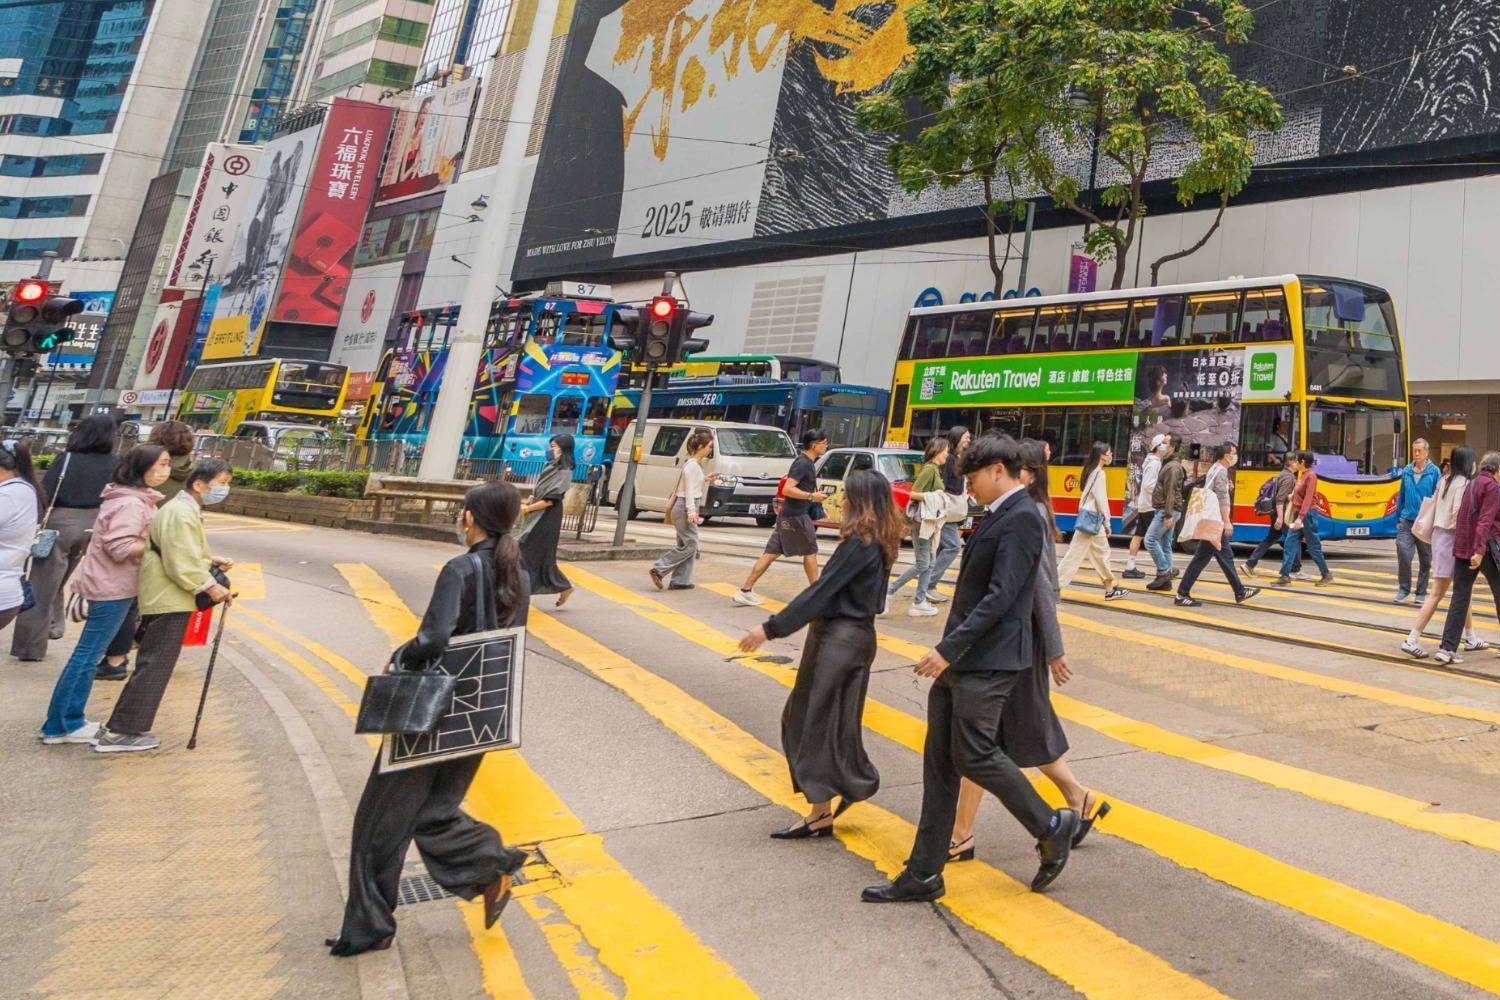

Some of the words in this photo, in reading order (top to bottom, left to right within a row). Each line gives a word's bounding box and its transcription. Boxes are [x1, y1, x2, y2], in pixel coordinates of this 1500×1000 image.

[328, 126, 363, 200] 六福珠寶
[641, 200, 694, 239] 2025
[699, 200, 751, 230] 敬请期待
[527, 247, 542, 257] MADE
[542, 245, 556, 255] WITH
[556, 243, 571, 254] LOVE
[571, 240, 582, 251] FOR
[582, 238, 594, 249] ZHU
[577, 284, 596, 295] 87
[544, 302, 557, 310] 87
[1253, 362, 1274, 372] Rakuten
[950, 370, 1000, 391] Rakuten
[1003, 368, 1041, 389] Travel
[1048, 370, 1065, 383] 酒店
[1253, 372, 1273, 382] Travel
